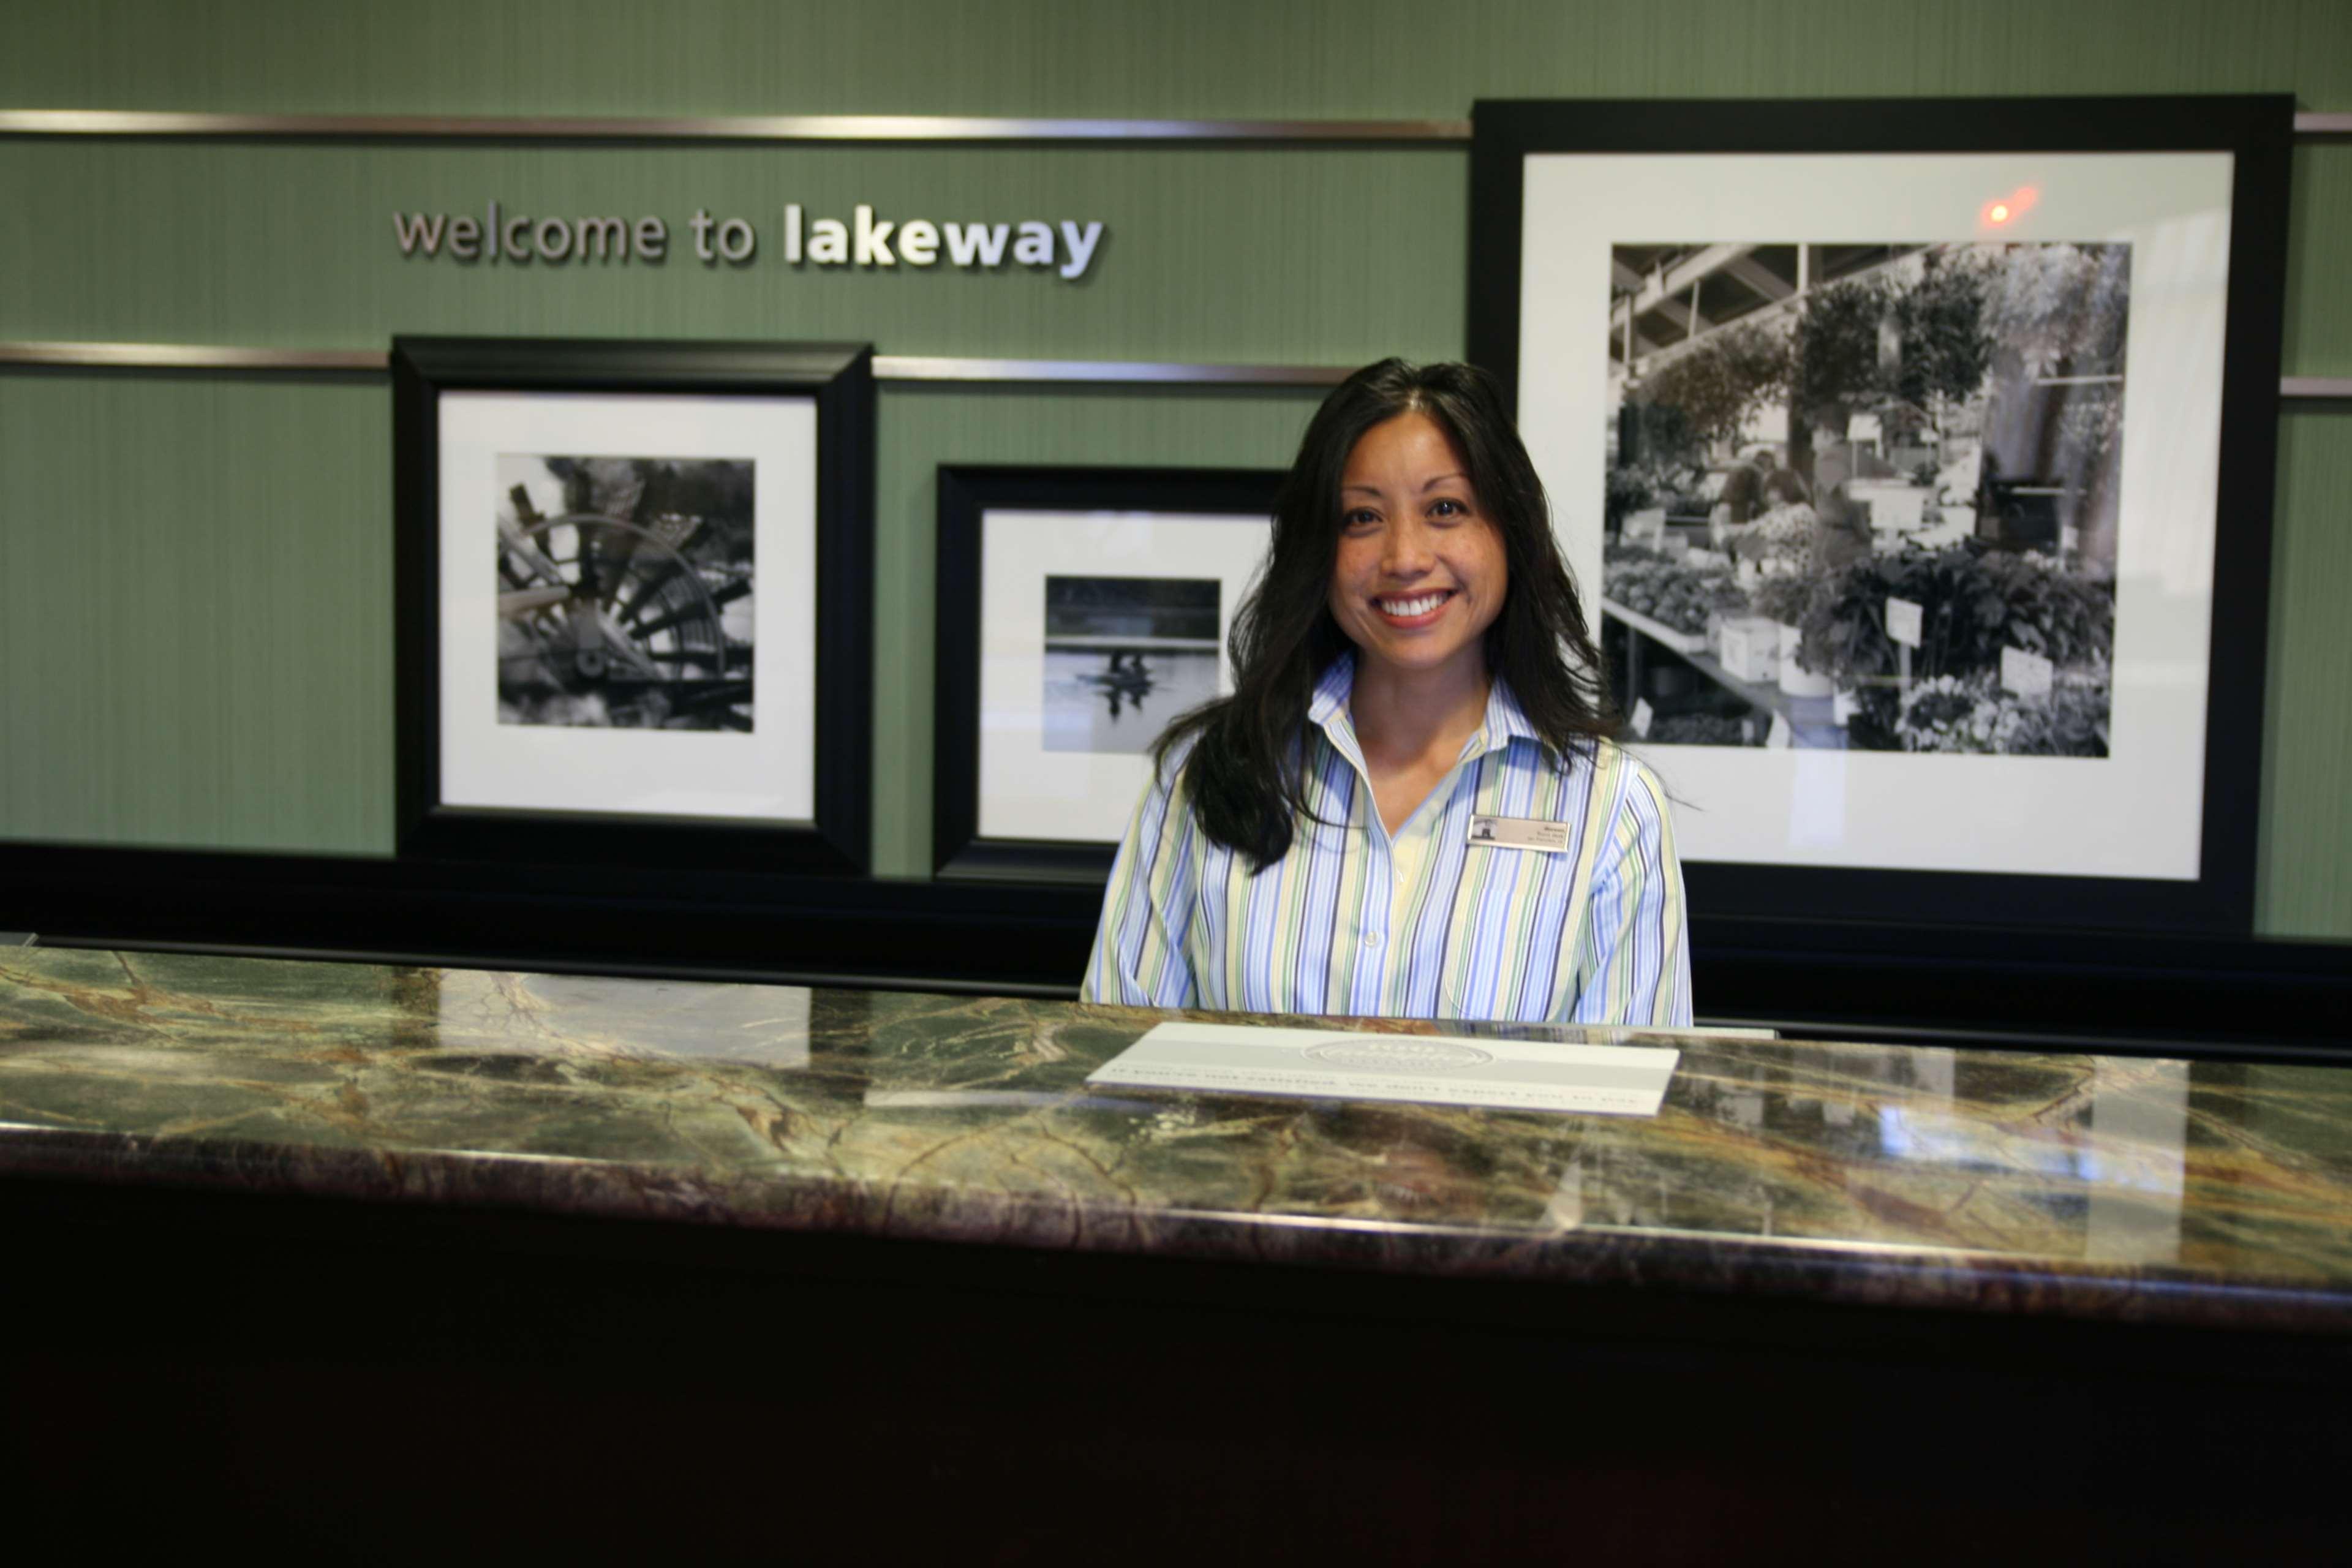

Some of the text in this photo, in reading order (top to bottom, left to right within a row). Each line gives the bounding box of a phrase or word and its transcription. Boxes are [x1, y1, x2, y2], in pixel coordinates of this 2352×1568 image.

[393, 200, 1102, 279] welcome to lakeway
